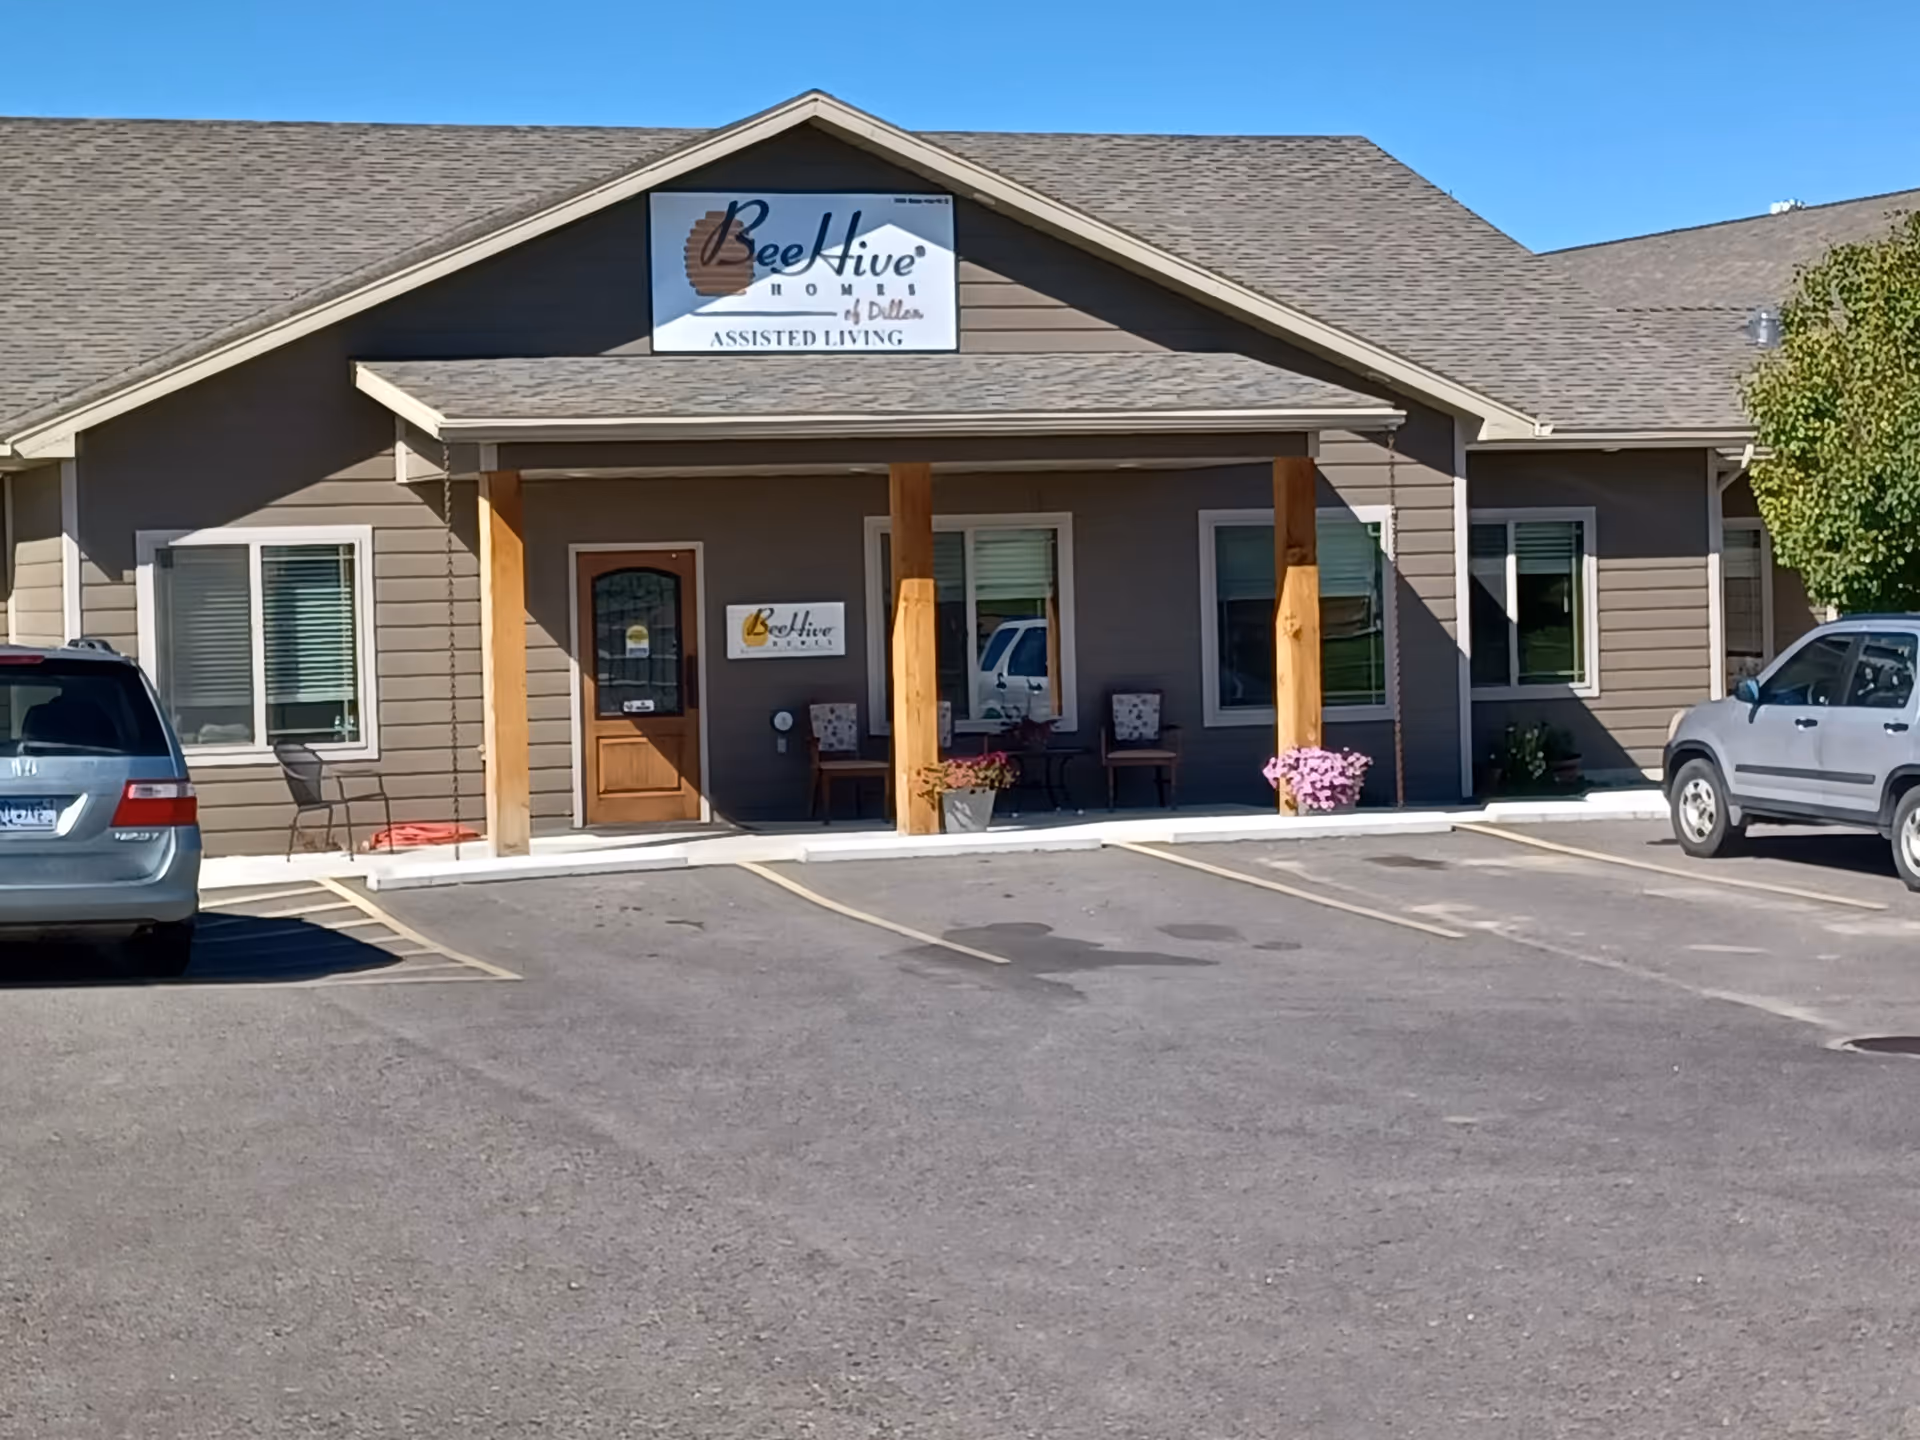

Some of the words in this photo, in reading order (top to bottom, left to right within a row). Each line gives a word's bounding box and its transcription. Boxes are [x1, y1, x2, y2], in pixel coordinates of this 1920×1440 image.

[701, 199, 917, 277] BeeHive
[710, 330, 817, 348] ASSISTED
[824, 330, 904, 347] LIVING
